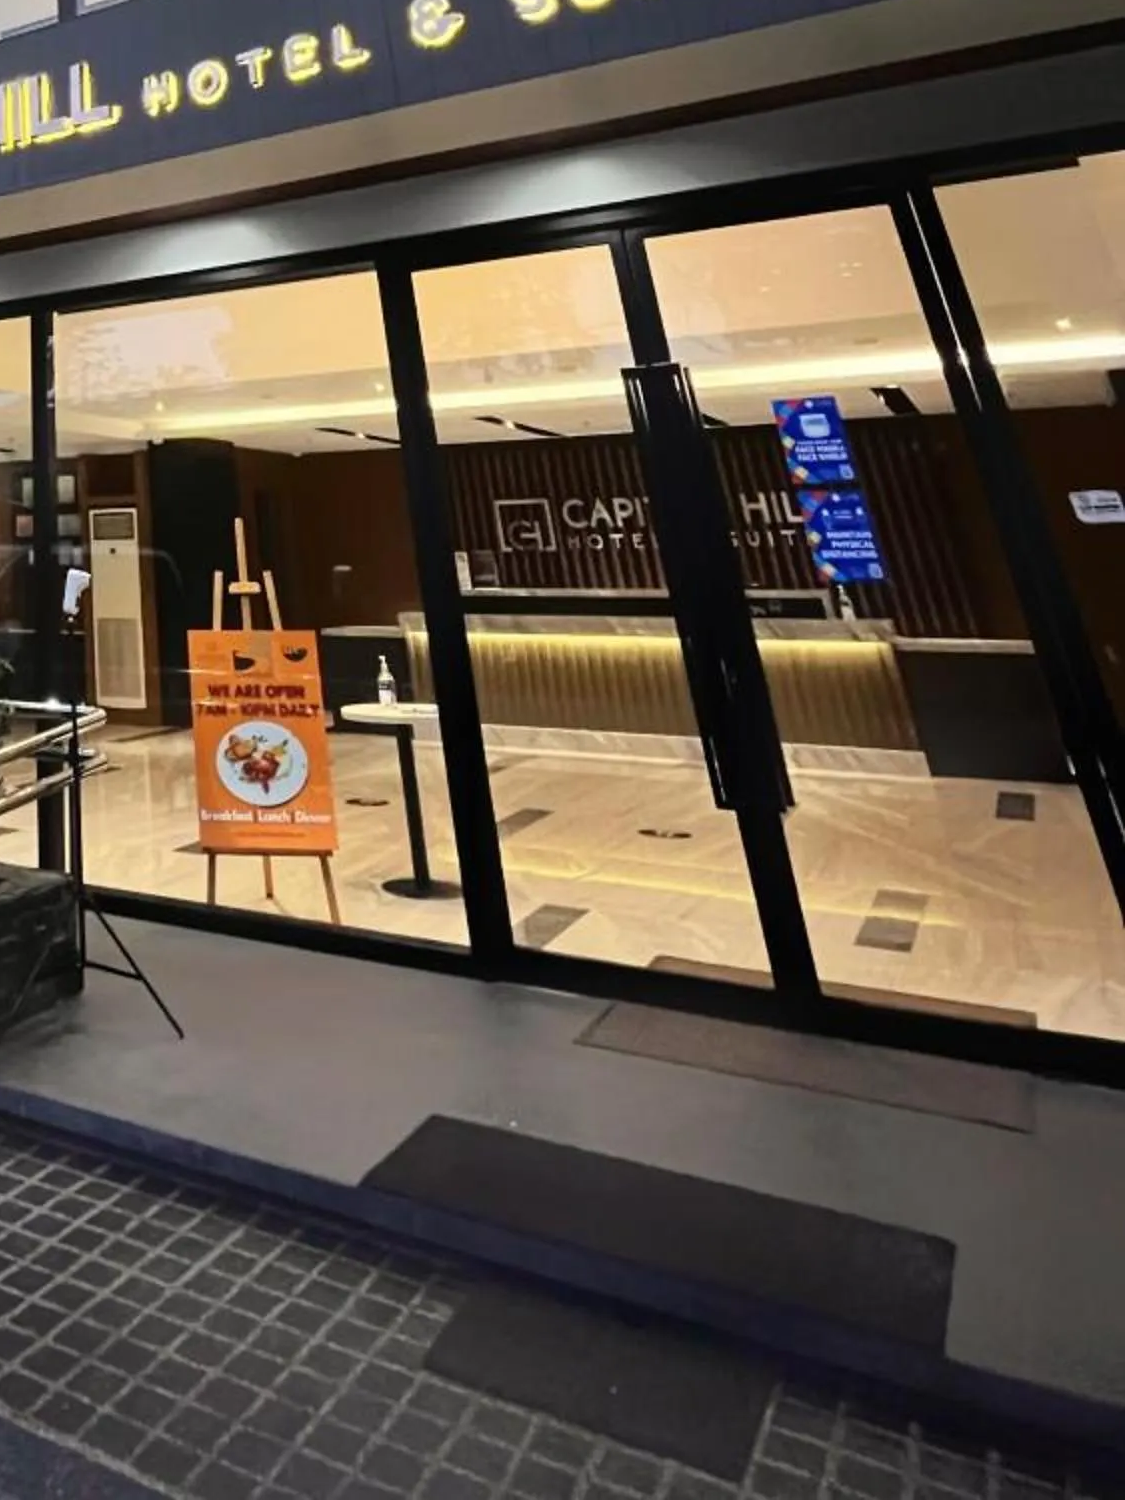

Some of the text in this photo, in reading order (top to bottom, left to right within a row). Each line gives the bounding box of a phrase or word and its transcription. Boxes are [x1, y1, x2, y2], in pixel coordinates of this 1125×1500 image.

[141, 24, 371, 118] HOTEL
[562, 497, 649, 529] CAPI
[738, 491, 803, 524] HIL
[568, 529, 796, 550] HOTE UIT
[235, 684, 261, 698] ARE
